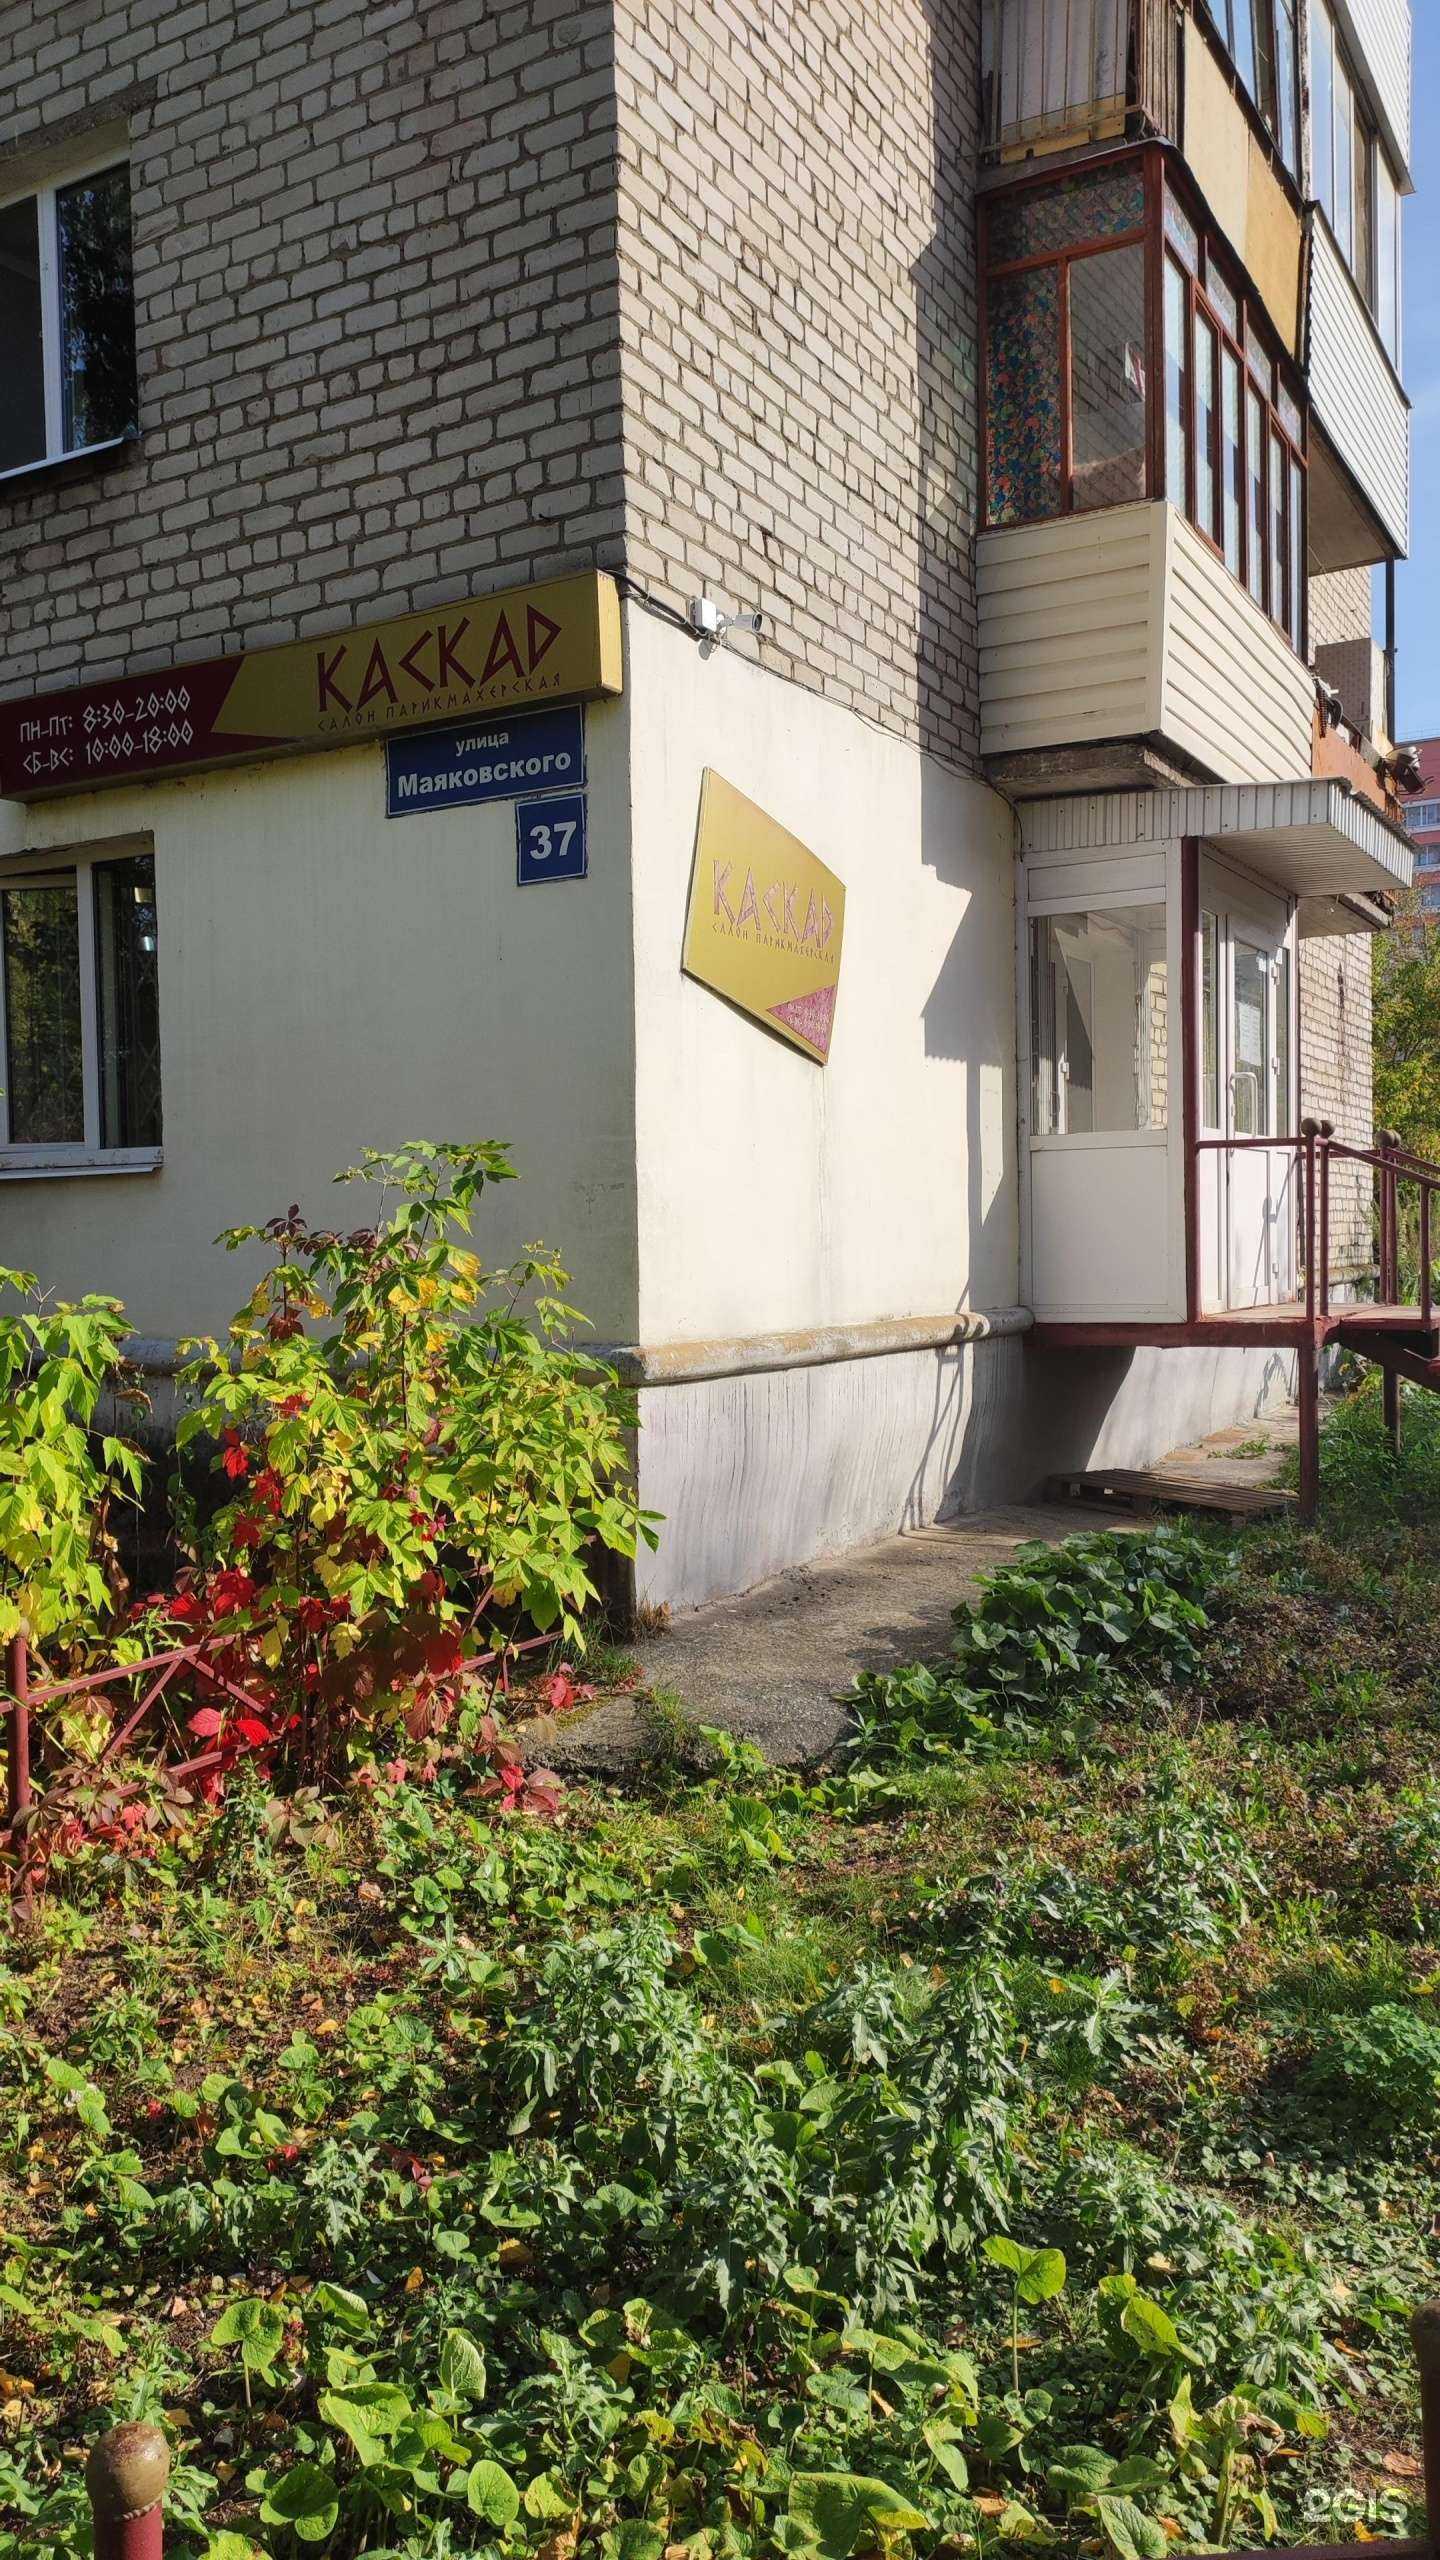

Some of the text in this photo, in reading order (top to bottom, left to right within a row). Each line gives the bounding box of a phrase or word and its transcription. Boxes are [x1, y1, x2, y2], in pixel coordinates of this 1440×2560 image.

[318, 672, 561, 732] САЛОН ПАРИКМАХЕРСКАЯ
[455, 732, 509, 757] улица
[397, 752, 571, 798] Маяковского
[529, 821, 577, 860] 37
